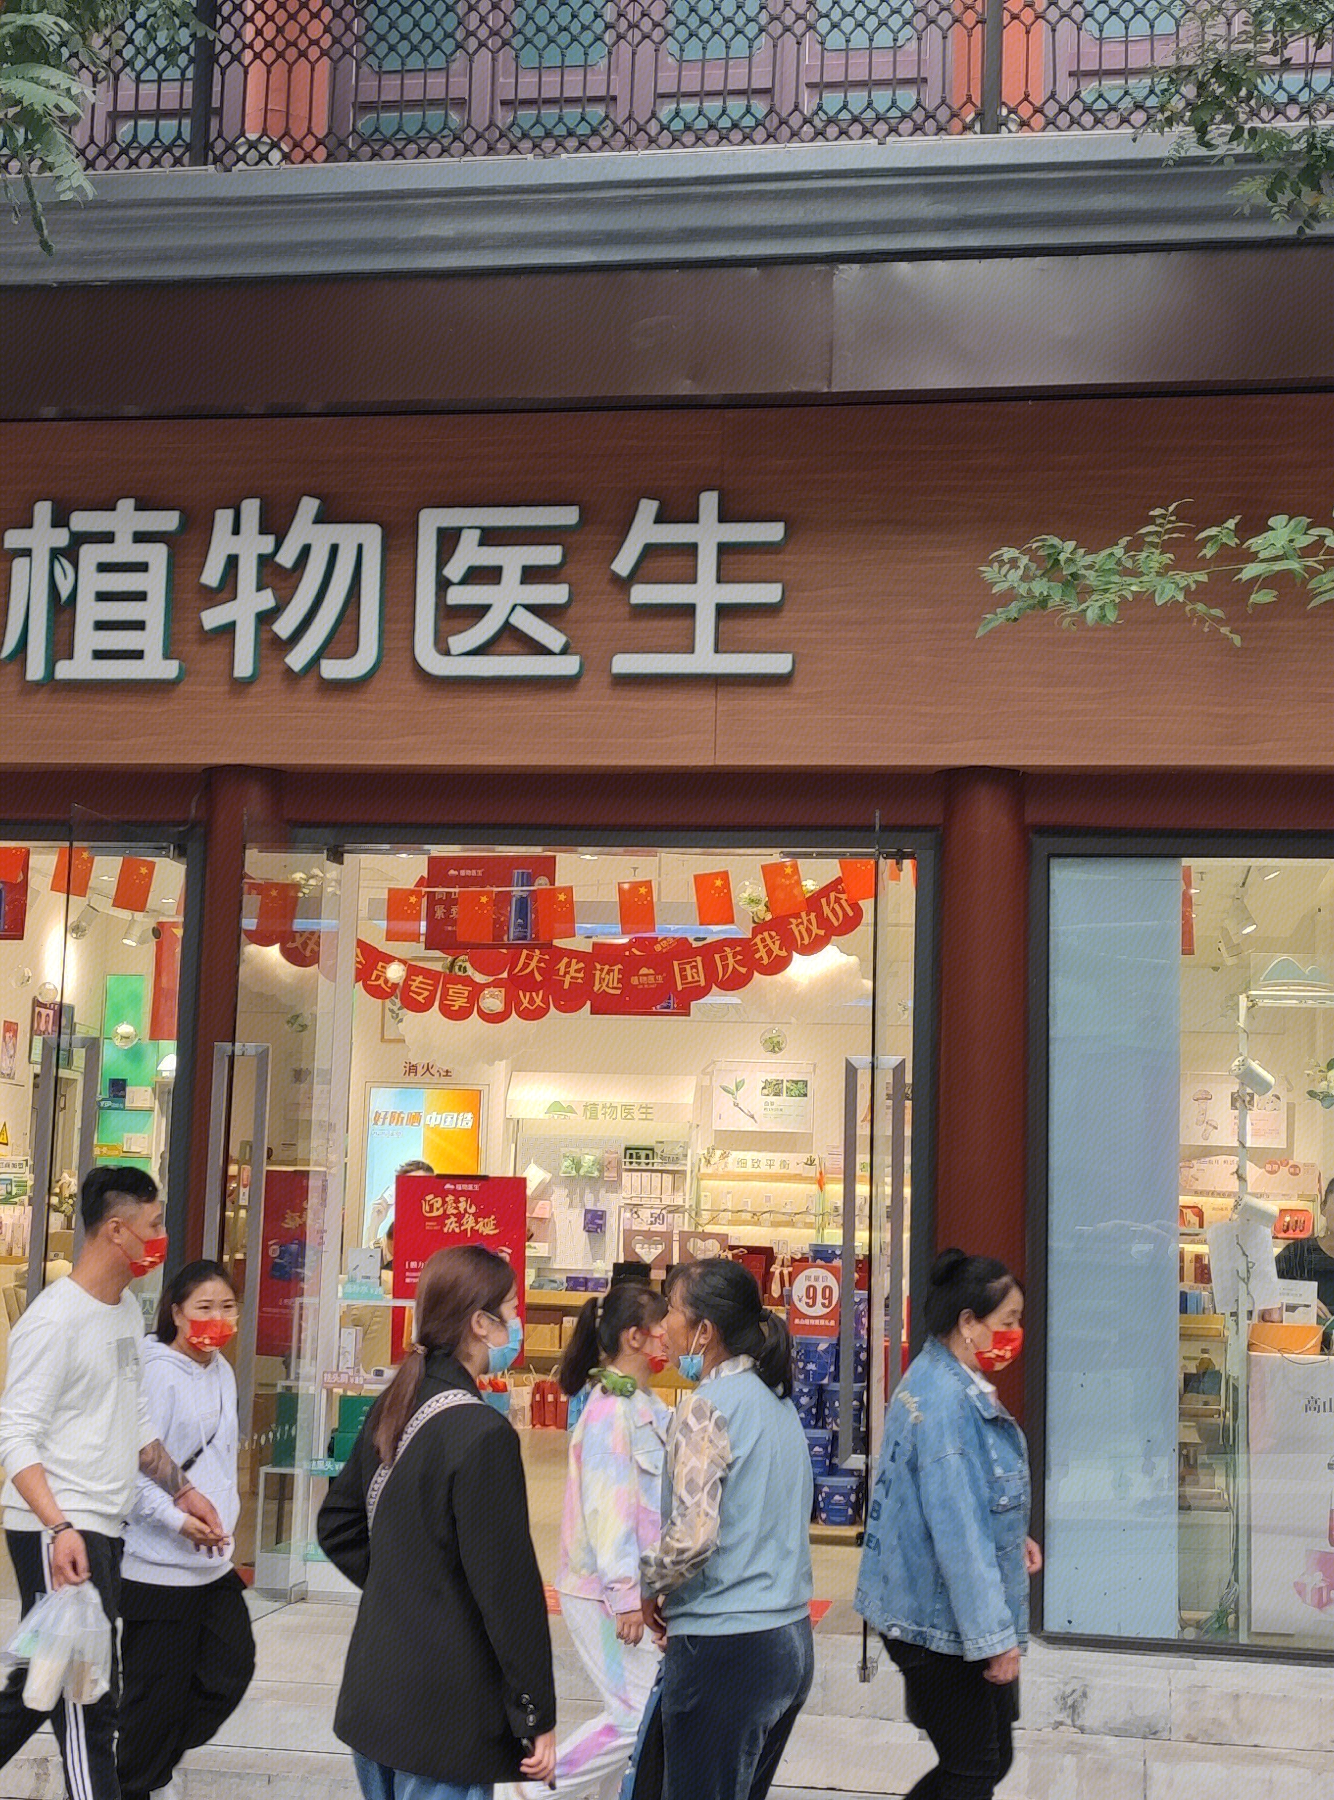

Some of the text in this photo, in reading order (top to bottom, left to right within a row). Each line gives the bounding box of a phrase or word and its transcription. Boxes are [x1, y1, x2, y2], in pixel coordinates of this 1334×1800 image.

[0, 490, 794, 685] 植物医生
[671, 889, 855, 992] 国庆我放价
[582, 1101, 655, 1122] 植物医生
[736, 1157, 791, 1171] 细致平衡
